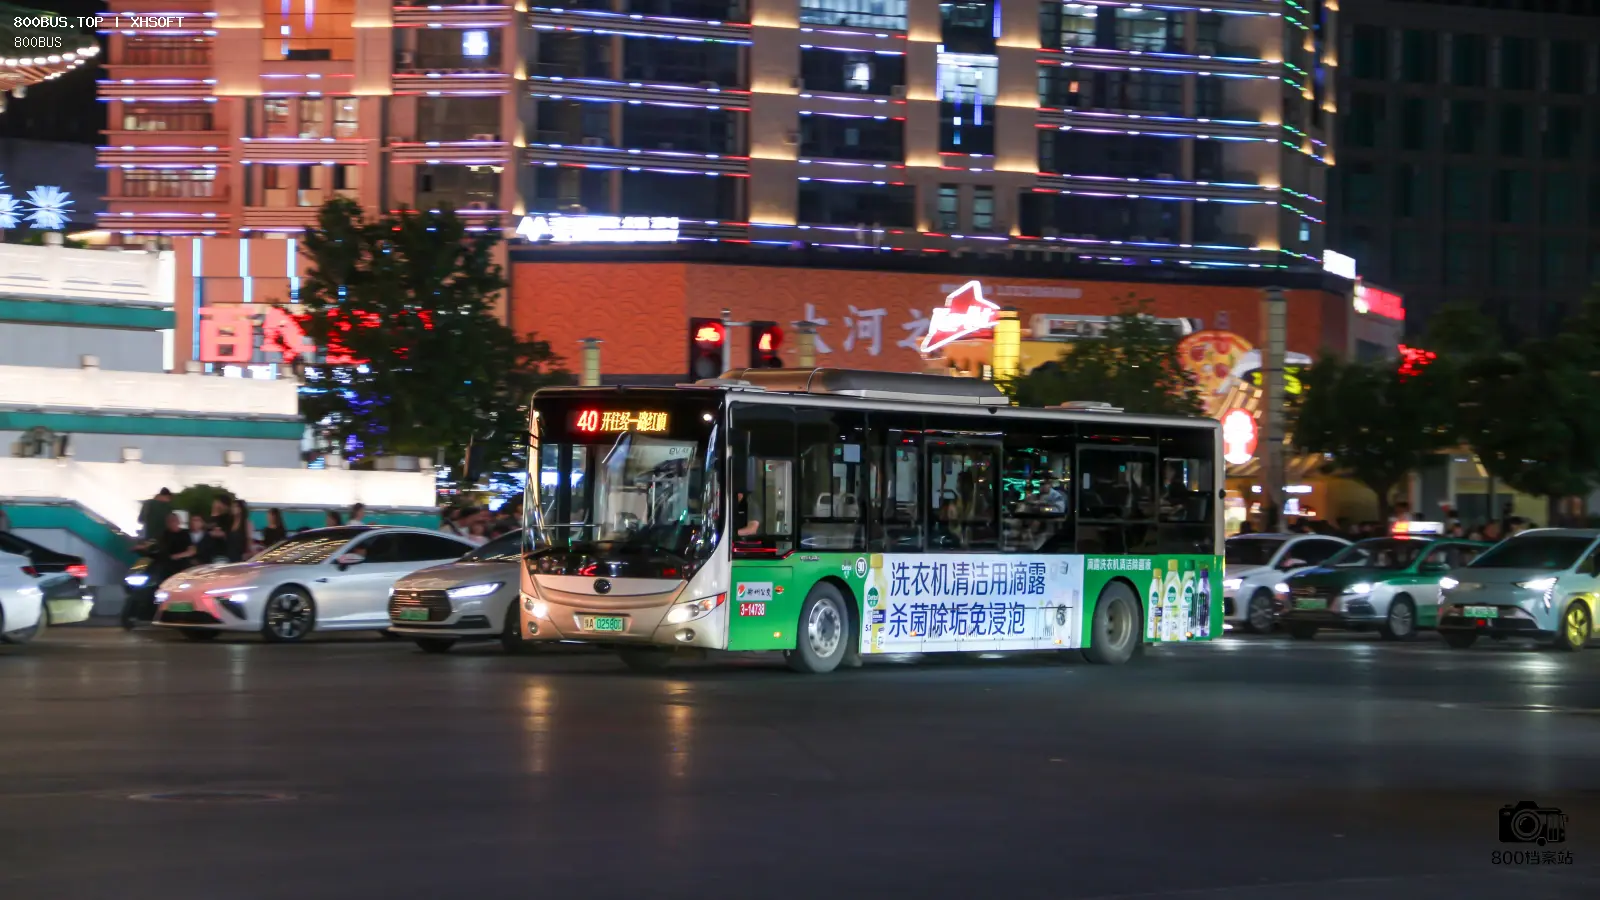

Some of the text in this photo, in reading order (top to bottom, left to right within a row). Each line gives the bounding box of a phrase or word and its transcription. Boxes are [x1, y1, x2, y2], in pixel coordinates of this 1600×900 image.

[577, 410, 598, 432] 40
[890, 561, 1046, 597] 洗衣机清洁用滴露
[740, 603, 765, 616] 3-14738
[889, 602, 1025, 638] 杀菌除垢免浸泡
